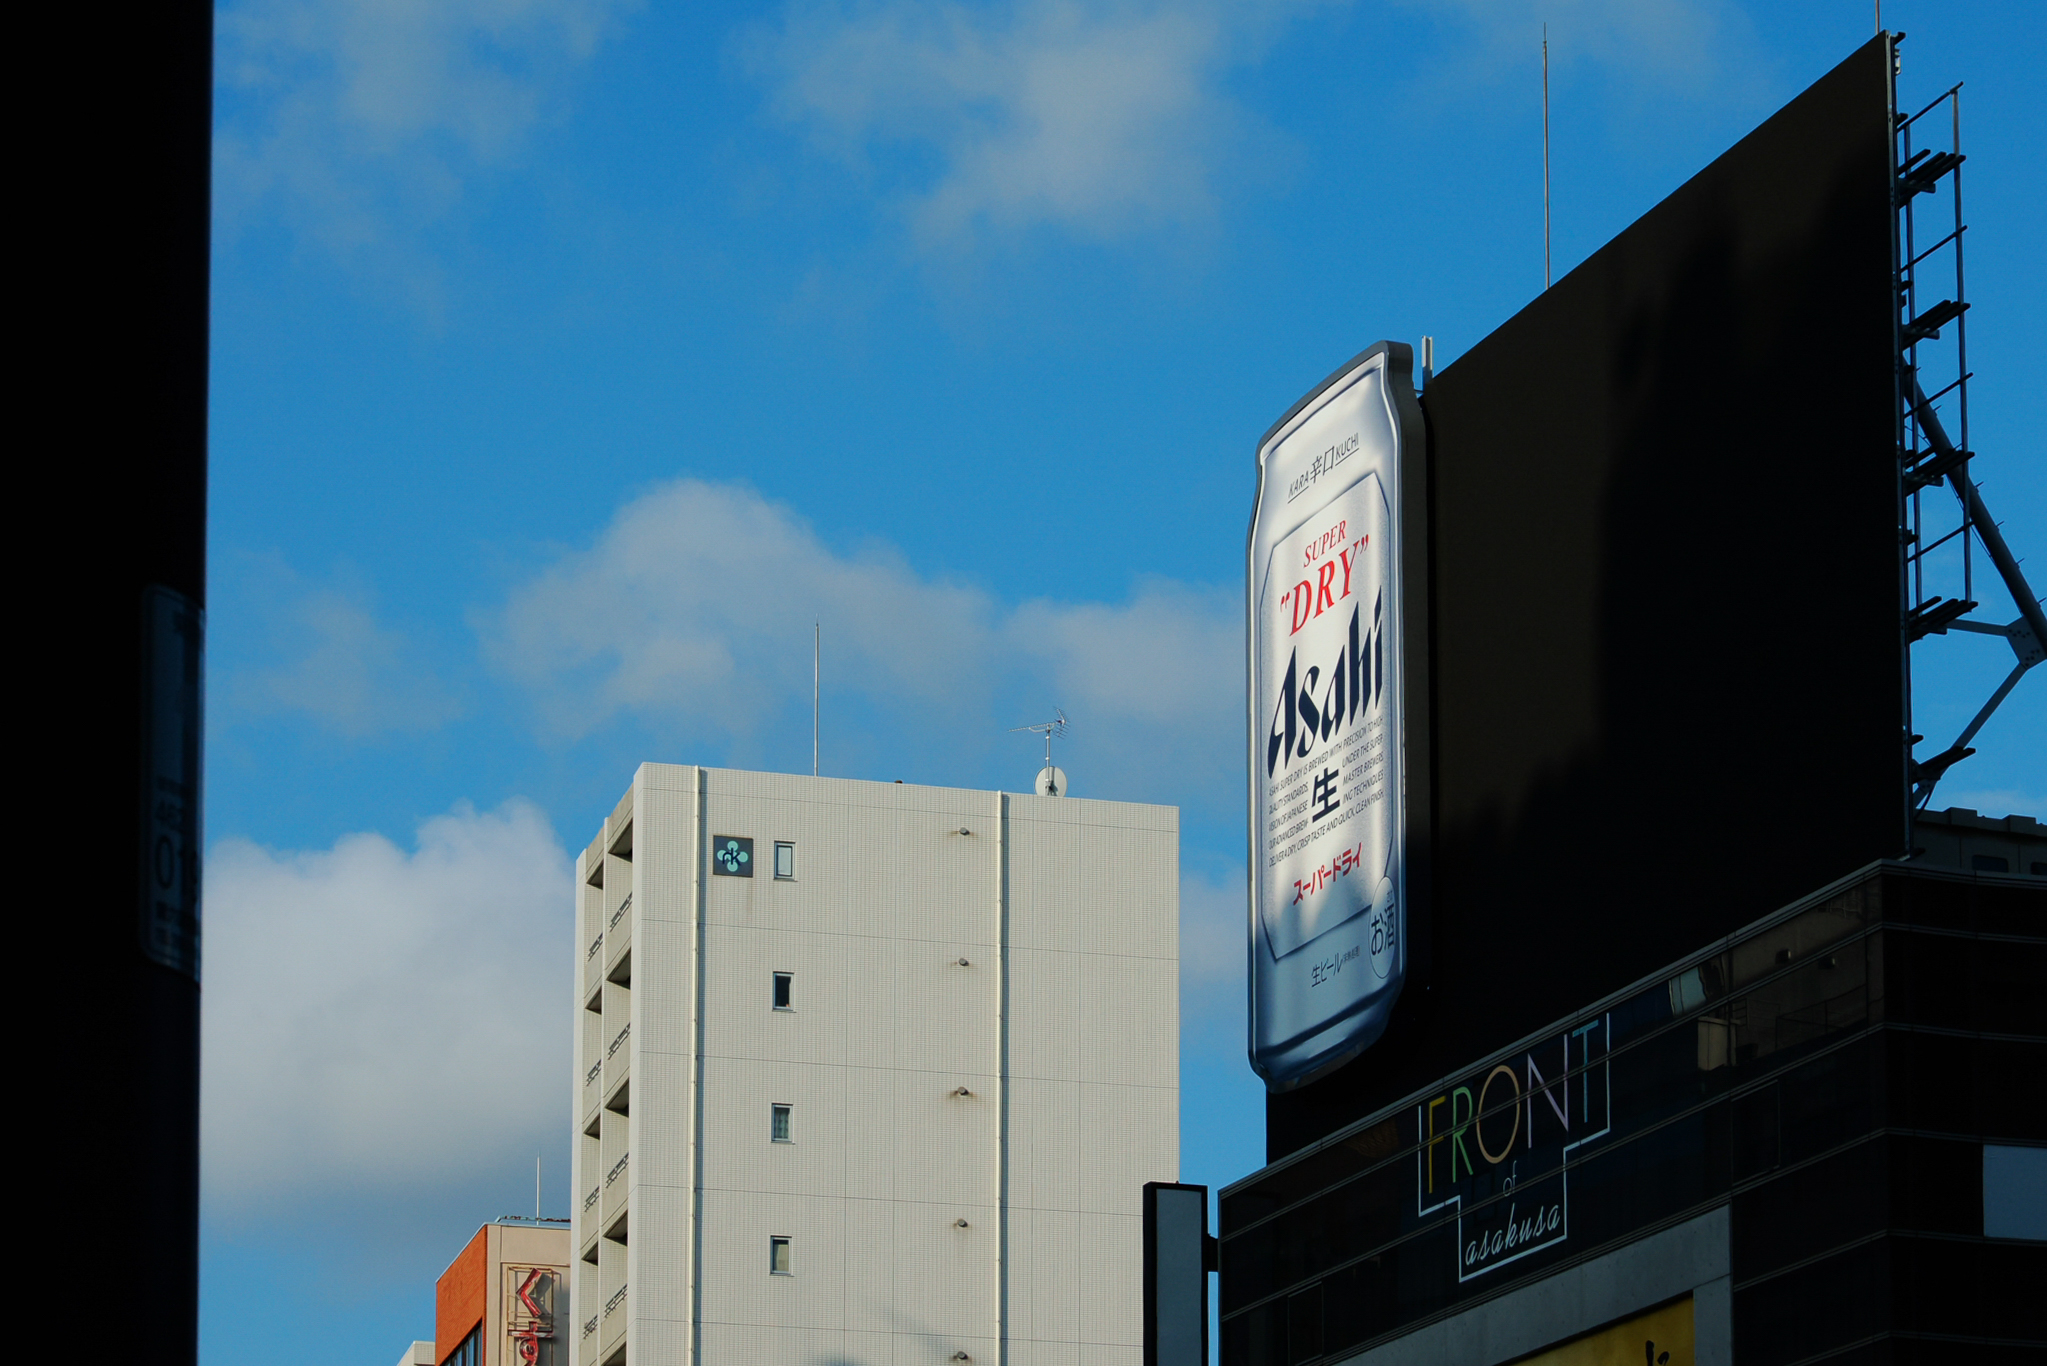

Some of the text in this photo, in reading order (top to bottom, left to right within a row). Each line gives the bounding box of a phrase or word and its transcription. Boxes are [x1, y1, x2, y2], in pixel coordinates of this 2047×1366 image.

[1288, 432, 1359, 498] KARA 辛口 KUCHI
[1303, 520, 1346, 568] SUPER
[1268, 585, 1382, 780] Asahi
[1280, 776, 1293, 789] SUPER
[1294, 770, 1303, 780] DRY
[1309, 752, 1328, 771] BREWED
[1343, 727, 1367, 748] PRECISION
[1342, 749, 1359, 767] UNDER
[1361, 743, 1370, 755] THE
[1343, 766, 1363, 784] MASTER
[1312, 767, 1340, 823] 生
[1293, 842, 1362, 906] スーパードライ
[1311, 952, 1343, 987] 生ビール
[1428, 1019, 1599, 1194] FRONT
[1502, 1160, 1518, 1197] of
[1465, 1202, 1560, 1265] asakusa
